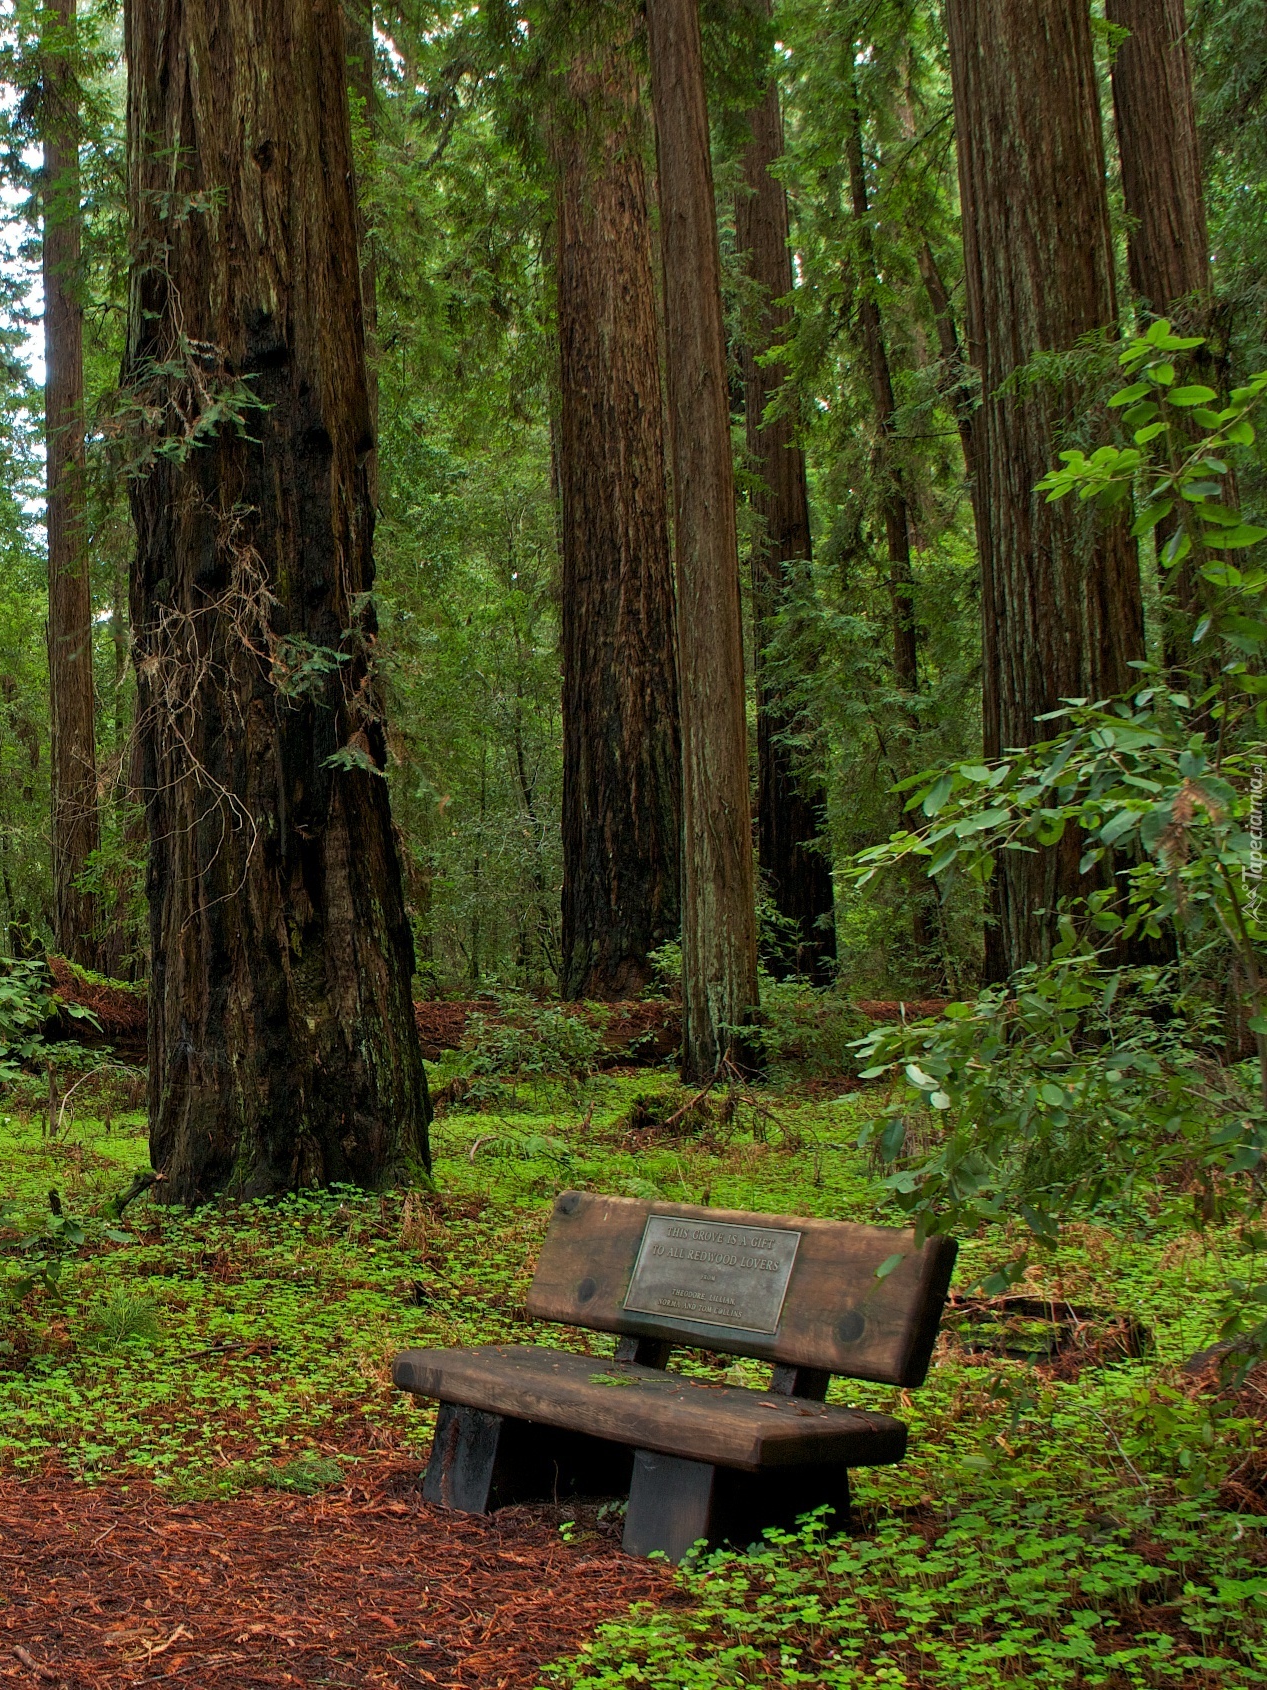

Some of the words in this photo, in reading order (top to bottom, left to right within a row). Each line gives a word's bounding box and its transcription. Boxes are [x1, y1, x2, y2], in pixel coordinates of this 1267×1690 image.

[667, 1227, 688, 1238] THIS
[692, 1230, 723, 1243] GROVE
[727, 1235, 737, 1244] IS
[739, 1237, 747, 1246] A
[751, 1238, 775, 1249] GIFT
[653, 1245, 665, 1256] TO
[667, 1248, 683, 1259] ALL
[687, 1250, 737, 1266] REDWOOD
[740, 1257, 779, 1271] LOVERS
[657, 1299, 681, 1309] NORMA
[682, 1303, 696, 1311] AND
[698, 1304, 712, 1313] TOM
[714, 1306, 742, 1317] COLLINS
